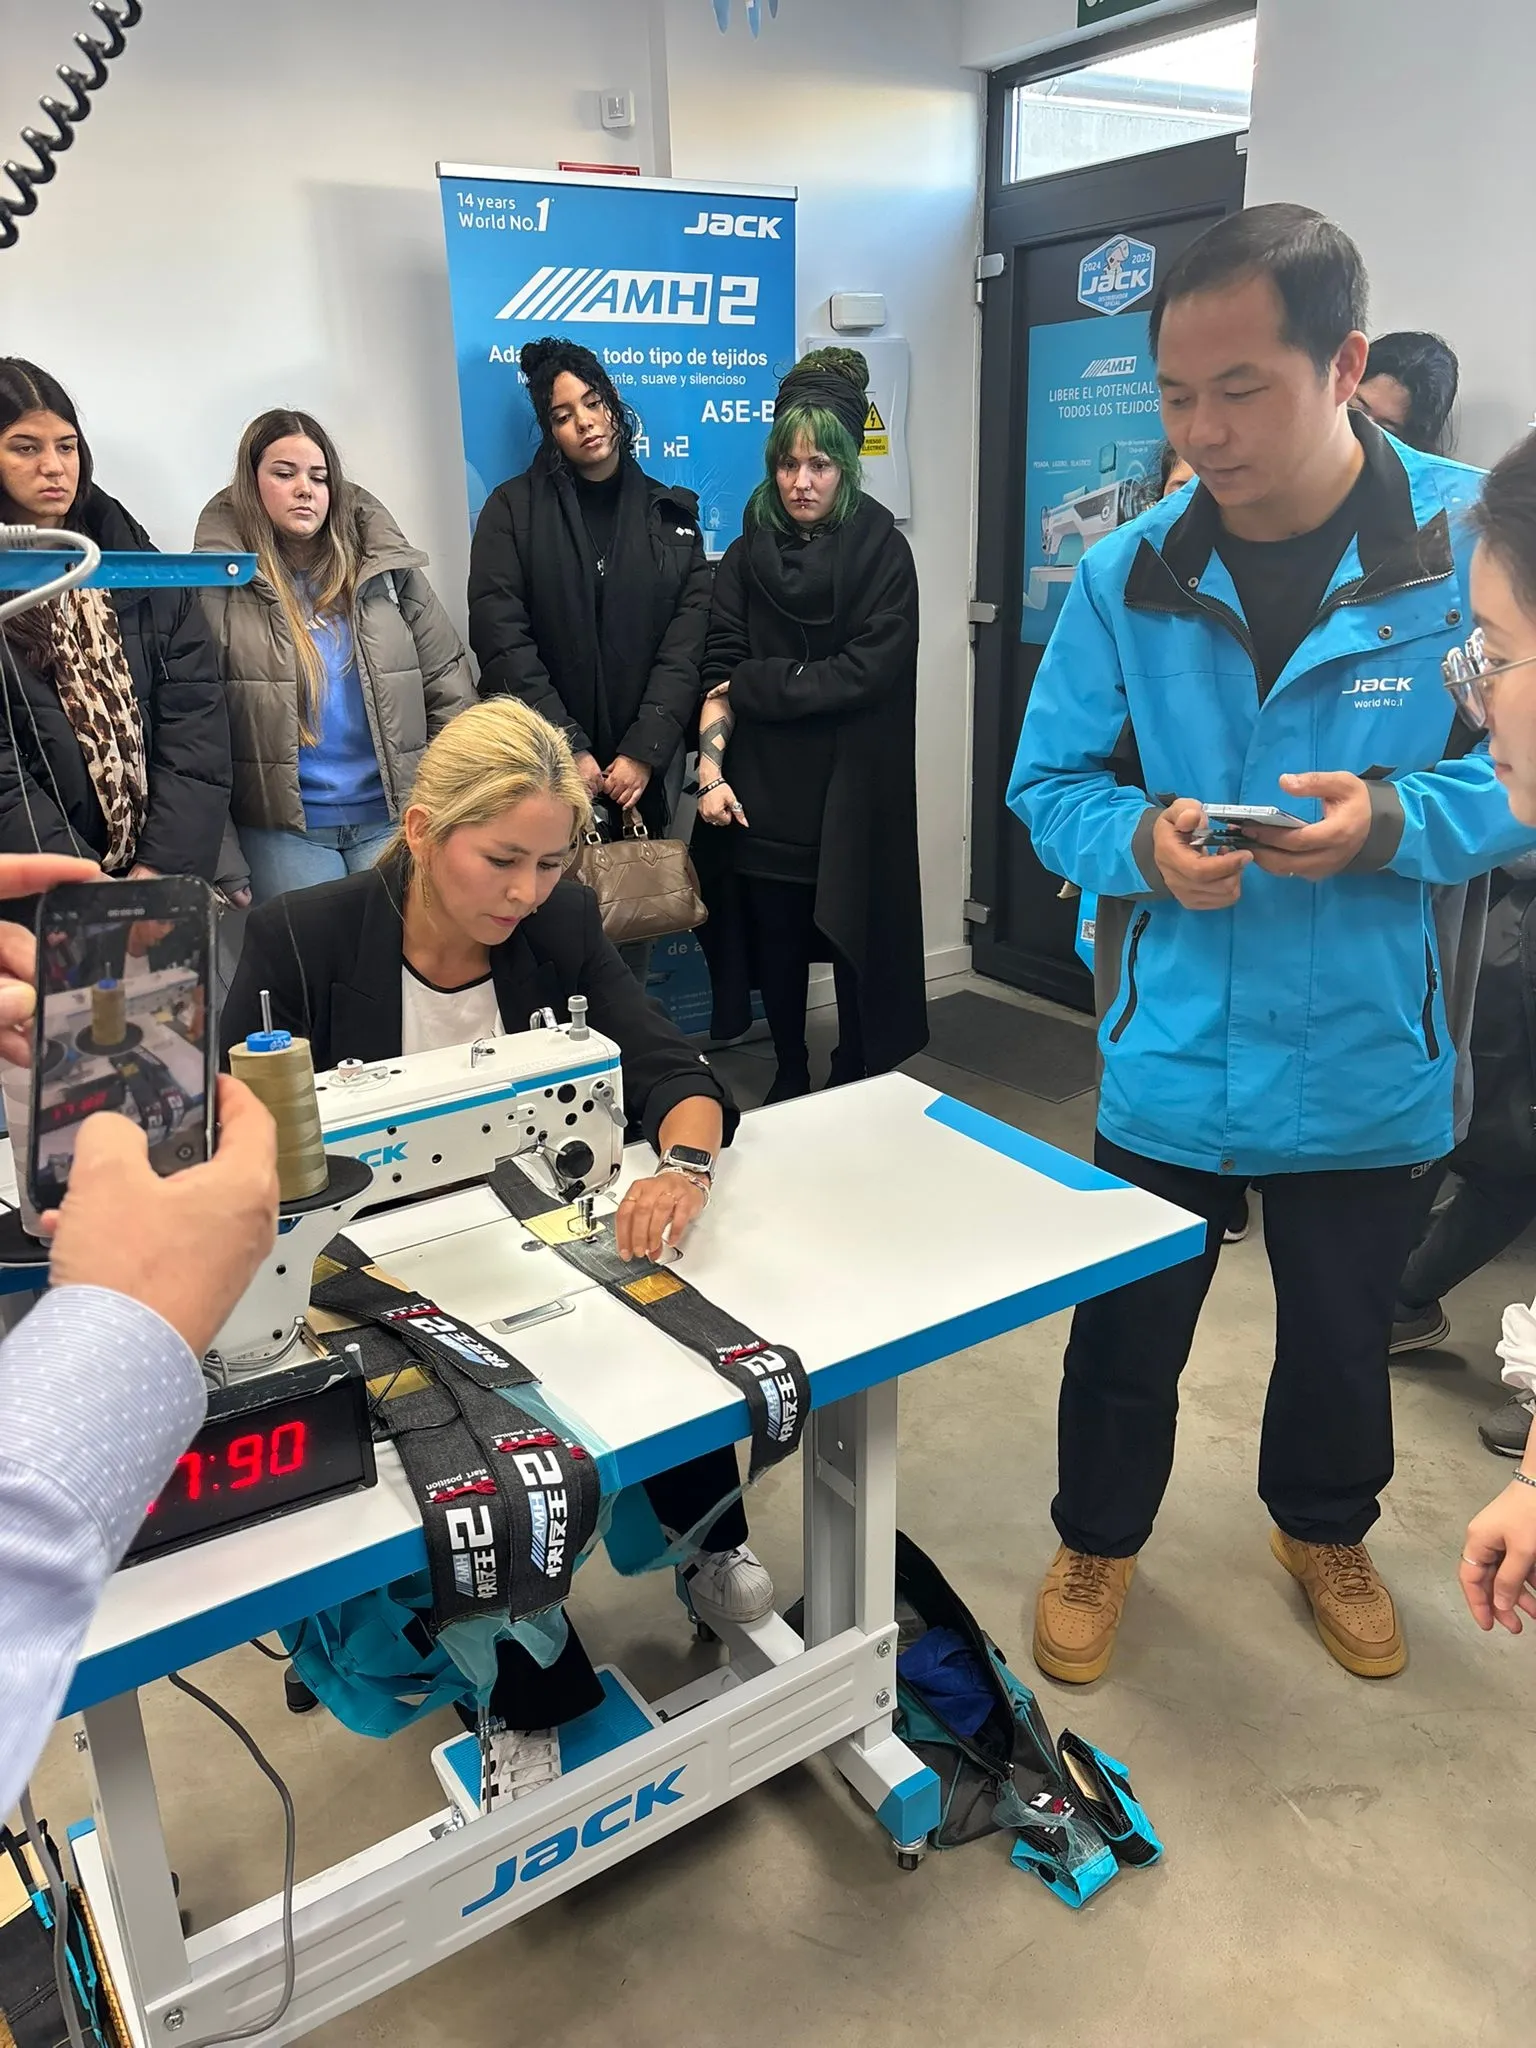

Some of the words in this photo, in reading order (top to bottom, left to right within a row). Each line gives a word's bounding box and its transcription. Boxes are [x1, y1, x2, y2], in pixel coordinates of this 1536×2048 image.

[456, 192, 475, 207] 14
[477, 197, 516, 211] years
[458, 212, 506, 229] World
[1084, 261, 1101, 273] 2024
[1132, 252, 1151, 264] 2025
[603, 349, 645, 364] todo
[649, 350, 684, 368] tipo
[687, 349, 707, 365] de
[711, 350, 769, 369] tejidos
[641, 375, 677, 385] suave
[680, 375, 687, 388] y
[689, 373, 747, 386] silencioso
[1049, 387, 1080, 402] LIBERE
[1082, 386, 1093, 399] EL
[1096, 381, 1155, 398] POTENCIAL
[1058, 404, 1091, 419] TODOS
[1094, 403, 1113, 416] LOS
[1115, 399, 1160, 415] TEJIDOS
[663, 436, 690, 458] x2
[1353, 699, 1381, 708] World
[1383, 698, 1403, 707] No.1
[668, 942, 688, 956] de
[354, 1141, 409, 1168] CK
[154, 1420, 306, 1506] 7:90
[425, 1473, 463, 1490] position
[466, 1468, 488, 1480] start
[445, 1505, 494, 1551] 2
